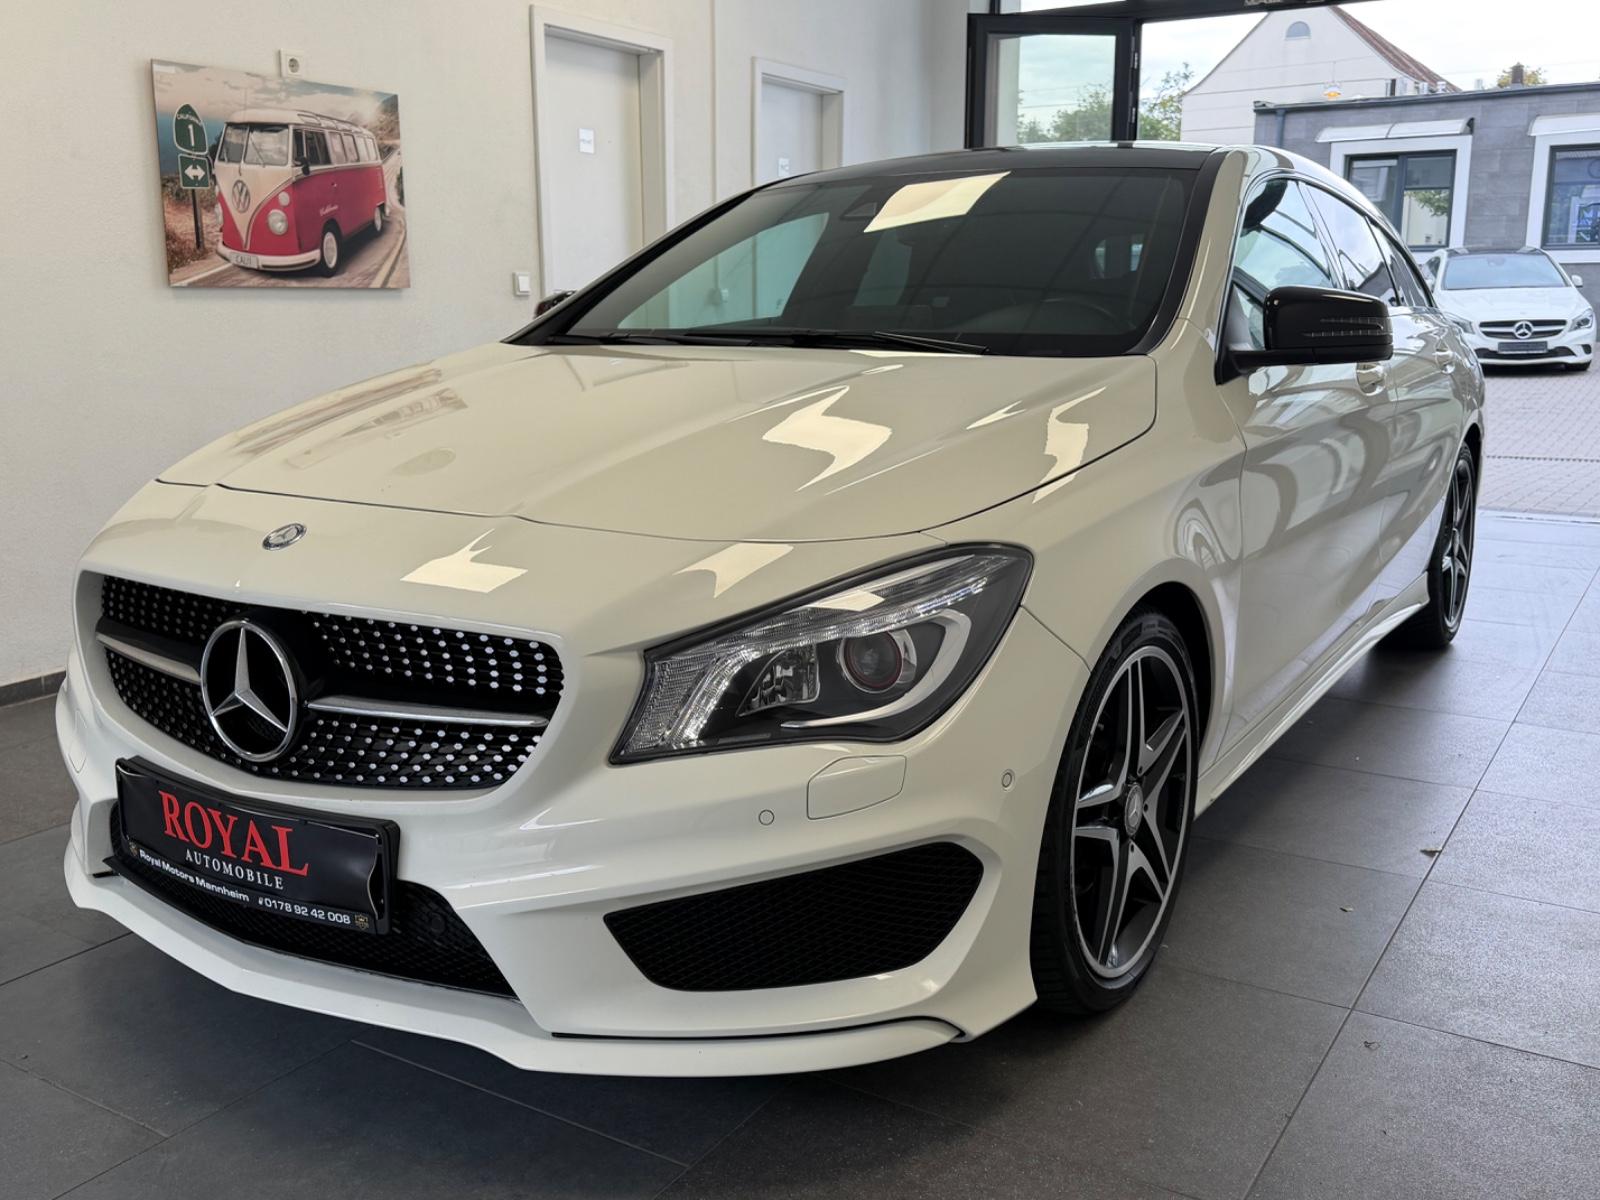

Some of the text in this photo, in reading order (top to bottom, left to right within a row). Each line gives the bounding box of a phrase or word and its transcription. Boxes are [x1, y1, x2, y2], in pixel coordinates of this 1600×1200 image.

[188, 124, 195, 147] 1
[158, 790, 309, 877] ROYAL
[139, 848, 352, 925] Royal Motors Mannheim 0178 92 42 008
[185, 848, 285, 891] AUTOMOBILE
